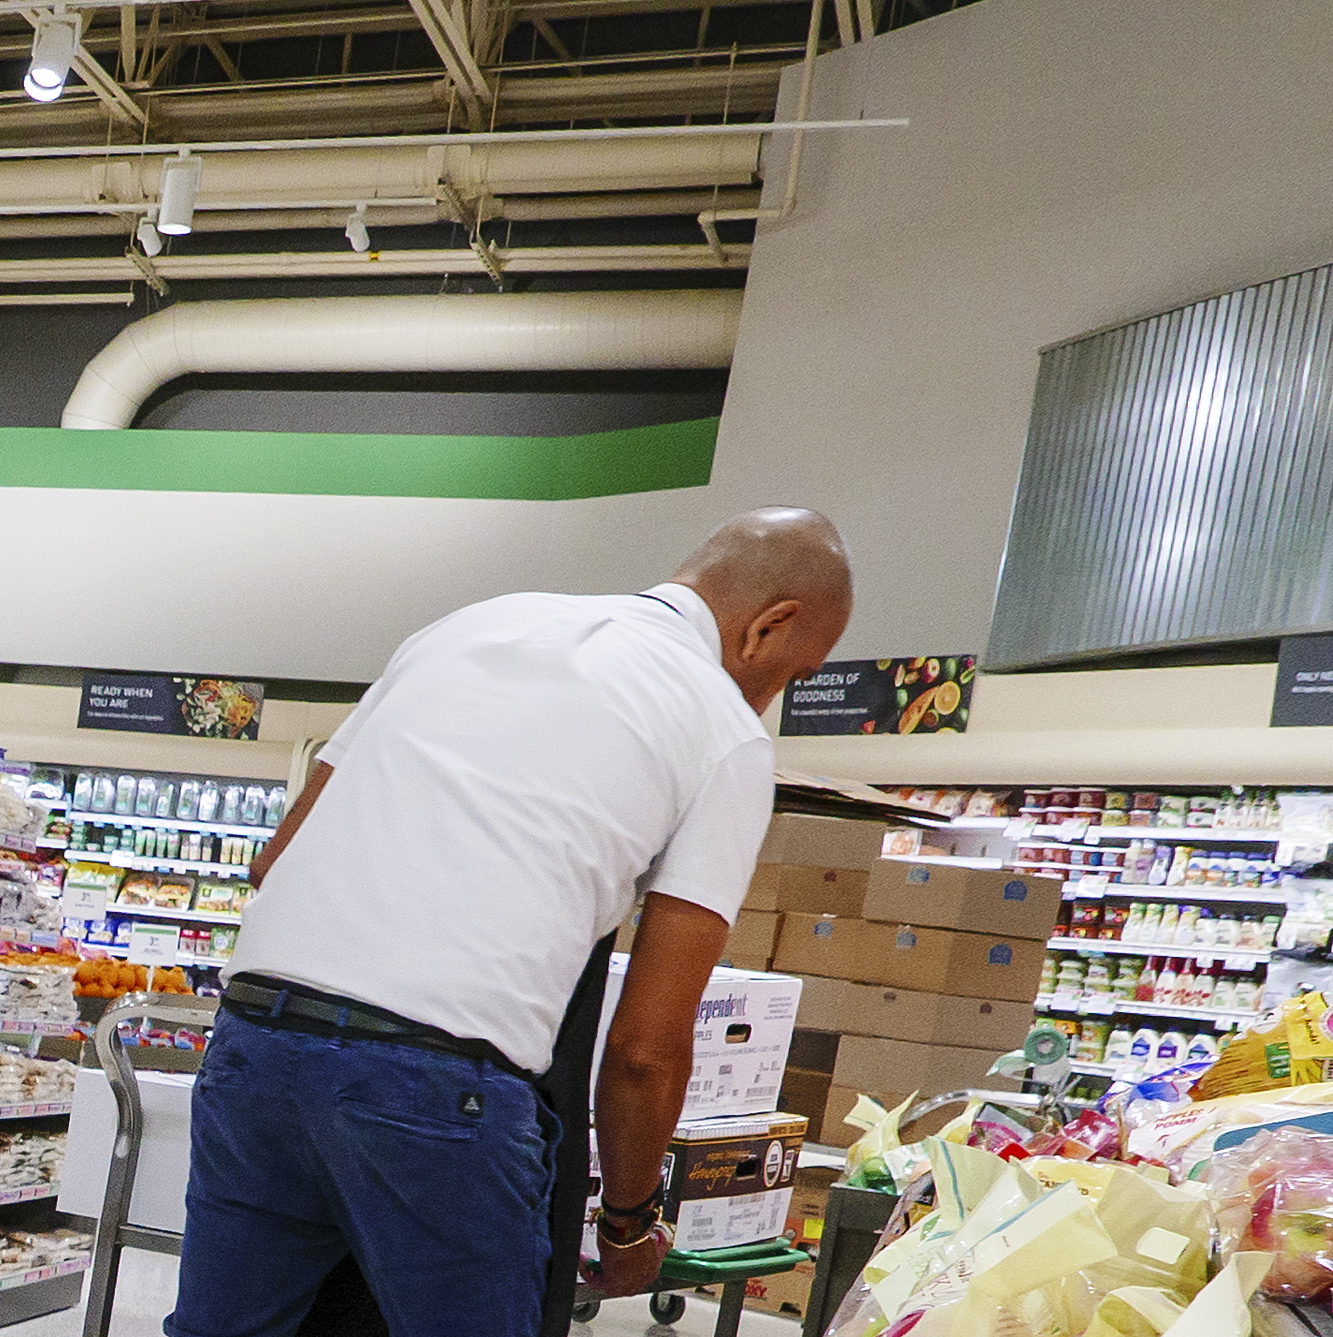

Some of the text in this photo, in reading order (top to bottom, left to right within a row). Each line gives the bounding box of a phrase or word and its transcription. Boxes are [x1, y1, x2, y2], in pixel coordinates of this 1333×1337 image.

[846, 672, 861, 684] OF
[90, 684, 154, 699] READY WHEN
[792, 689, 846, 703] GOODNESS
[89, 697, 129, 708] YOU ARE
